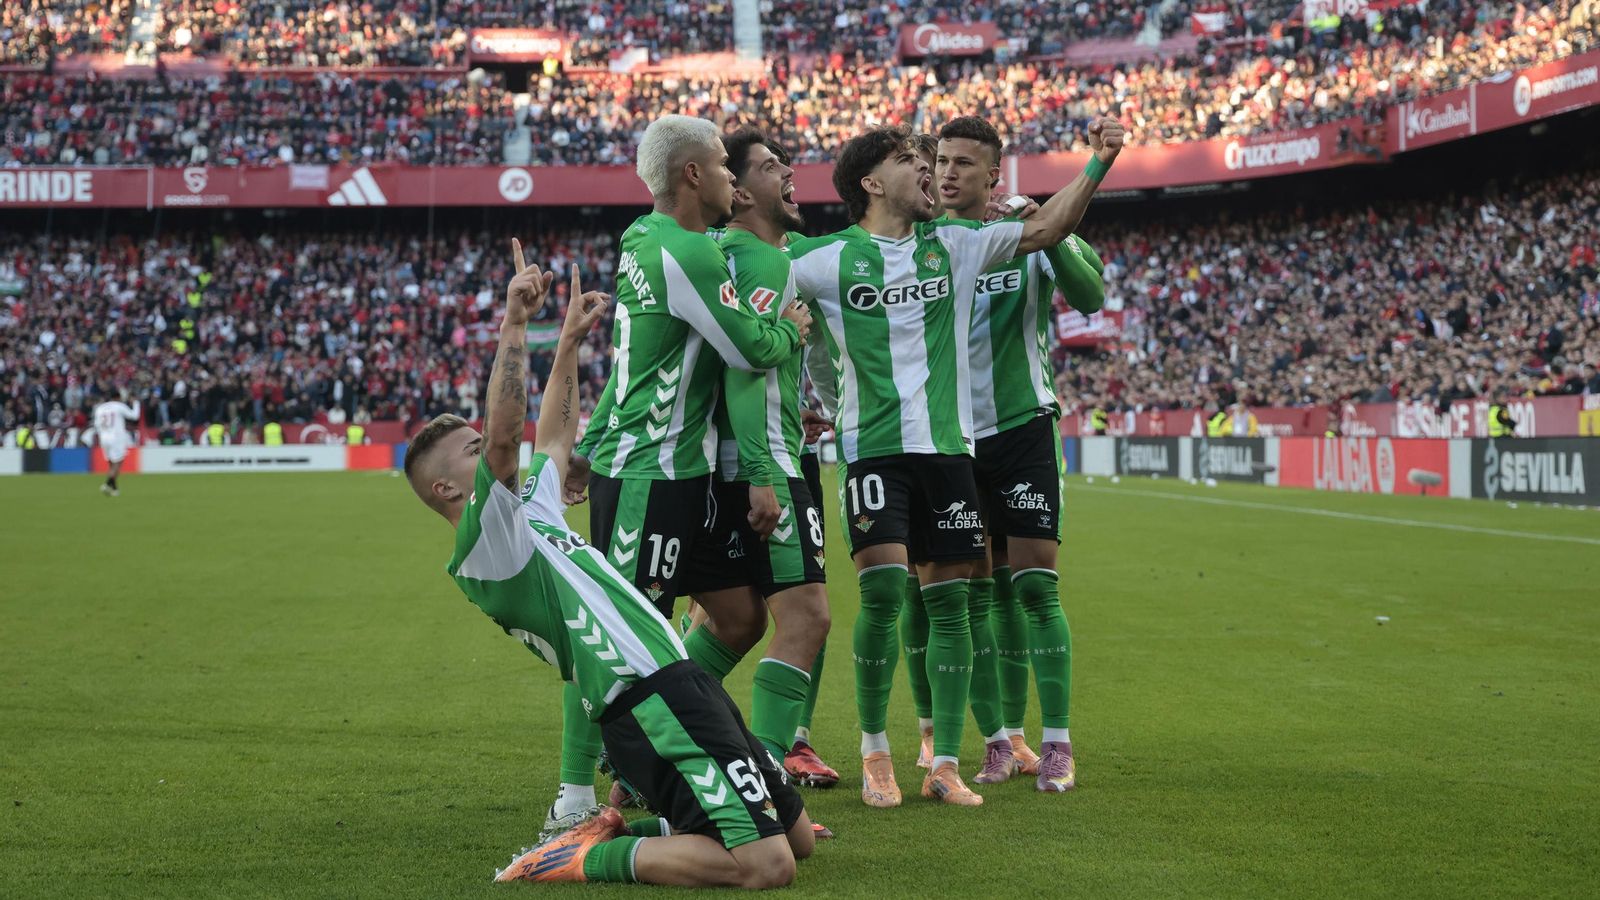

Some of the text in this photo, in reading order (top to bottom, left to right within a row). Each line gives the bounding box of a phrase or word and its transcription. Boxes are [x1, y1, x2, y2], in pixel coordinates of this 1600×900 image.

[1224, 136, 1320, 170] Cruzcampo
[0, 171, 94, 202] RINDE
[882, 277, 947, 305] GREE
[1128, 444, 1169, 471] SEVILLA
[1208, 446, 1253, 475] SEVILLA
[1313, 437, 1374, 494] LALIGA
[1501, 451, 1586, 494] SEVILLA
[848, 473, 886, 516] 10
[1007, 499, 1052, 512] GLOBAL
[1019, 492, 1045, 502] AUS
[806, 507, 824, 547] 8
[938, 520, 983, 529] GLOBAL
[955, 511, 978, 520] AUS
[648, 533, 681, 580] 19
